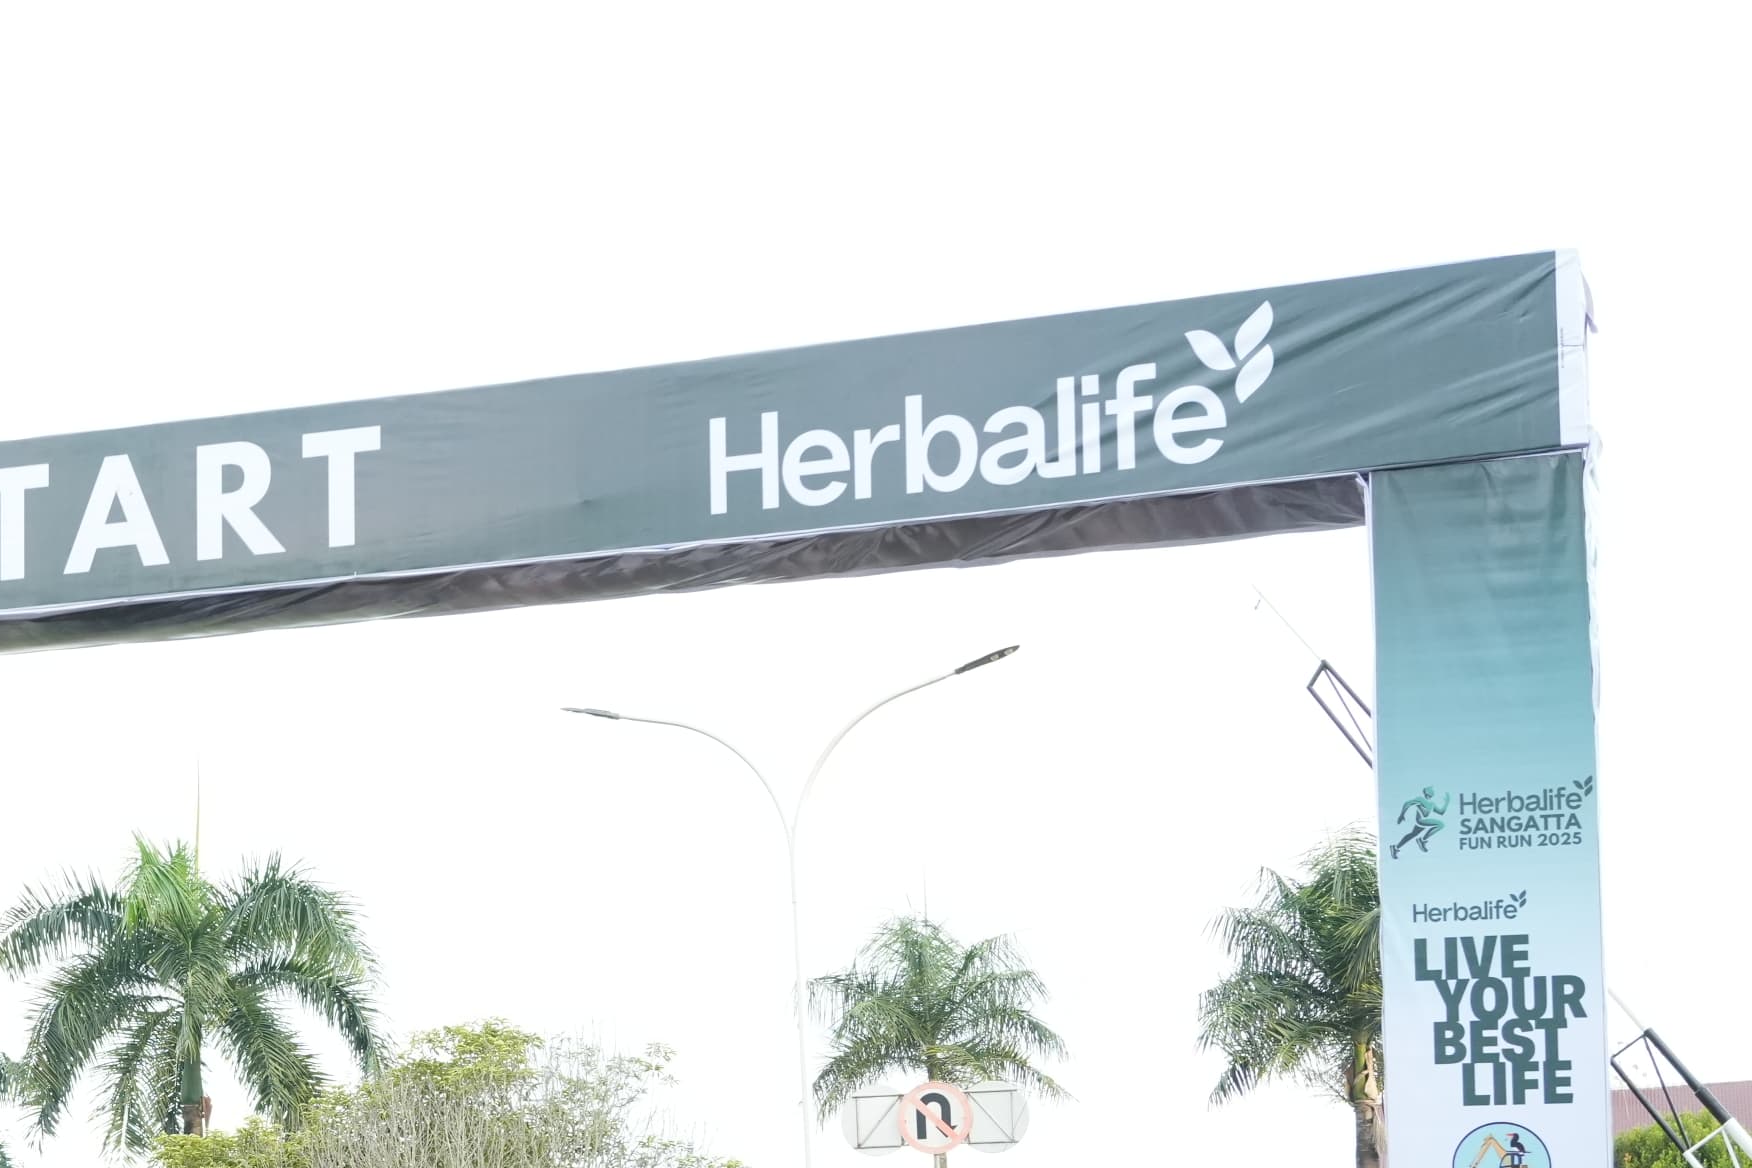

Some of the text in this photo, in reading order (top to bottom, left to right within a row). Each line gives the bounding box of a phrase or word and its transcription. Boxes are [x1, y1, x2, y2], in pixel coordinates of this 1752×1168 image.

[709, 363, 1228, 515] Herbalife
[1459, 786, 1583, 815] Herbalife
[1459, 813, 1582, 835] SANGATTA
[1459, 832, 1582, 850] FUN RUN 2025
[1412, 900, 1518, 923] Herbalife
[1414, 934, 1531, 981] LIVE
[1435, 975, 1587, 1023] YOUR
[1433, 1018, 1567, 1064] BEST
[1462, 1060, 1574, 1106] LIFE
